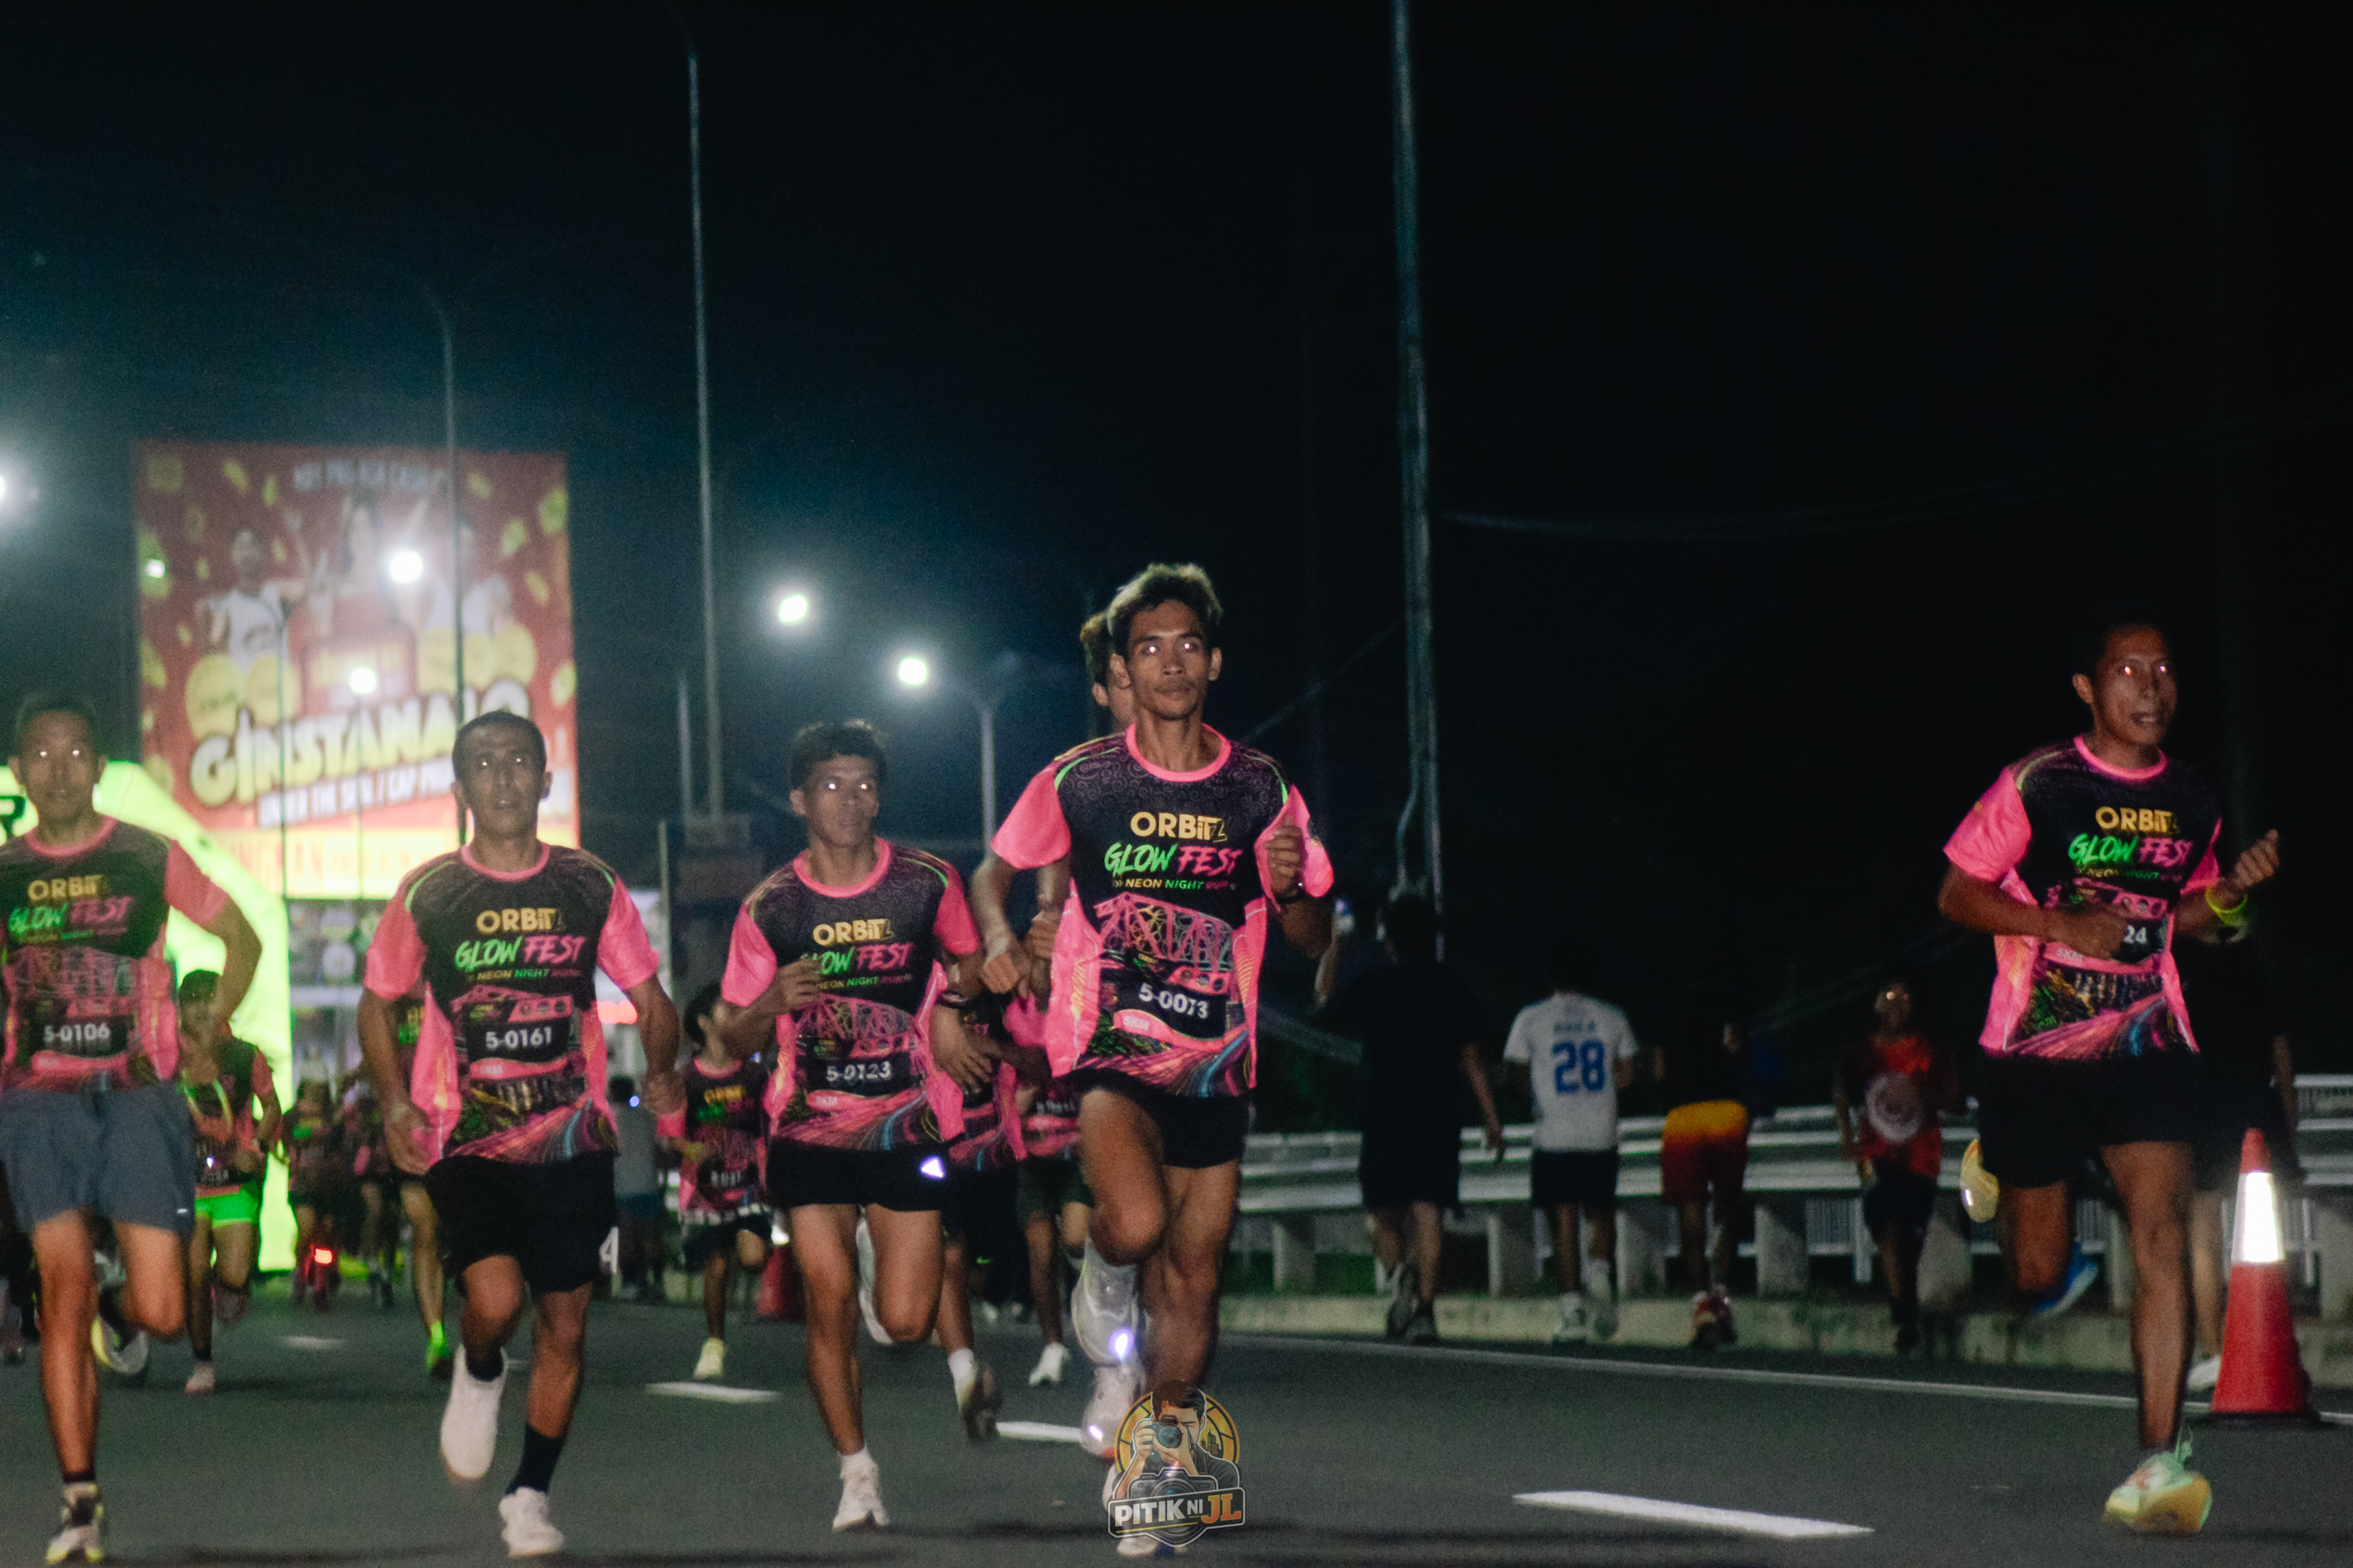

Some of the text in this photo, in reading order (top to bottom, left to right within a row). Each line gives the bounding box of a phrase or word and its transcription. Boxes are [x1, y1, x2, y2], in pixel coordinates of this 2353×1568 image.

[1103, 842, 1244, 877] GLOW FEST
[2068, 833, 2139, 866] GLOW
[1125, 878, 1163, 888] NEON
[1164, 879, 1204, 890] NIGHT
[455, 934, 587, 973] GLOW FEST
[857, 942, 914, 971] FEST
[477, 971, 512, 981] NEON
[514, 968, 550, 979] NIGHT
[846, 975, 879, 987] NIGHT
[43, 1022, 112, 1044] 5-0106
[1122, 1015, 1151, 1032] 5KM
[486, 1026, 552, 1050] 5-0161
[826, 1060, 892, 1082] 5-0123
[1553, 1040, 1605, 1095] 28
